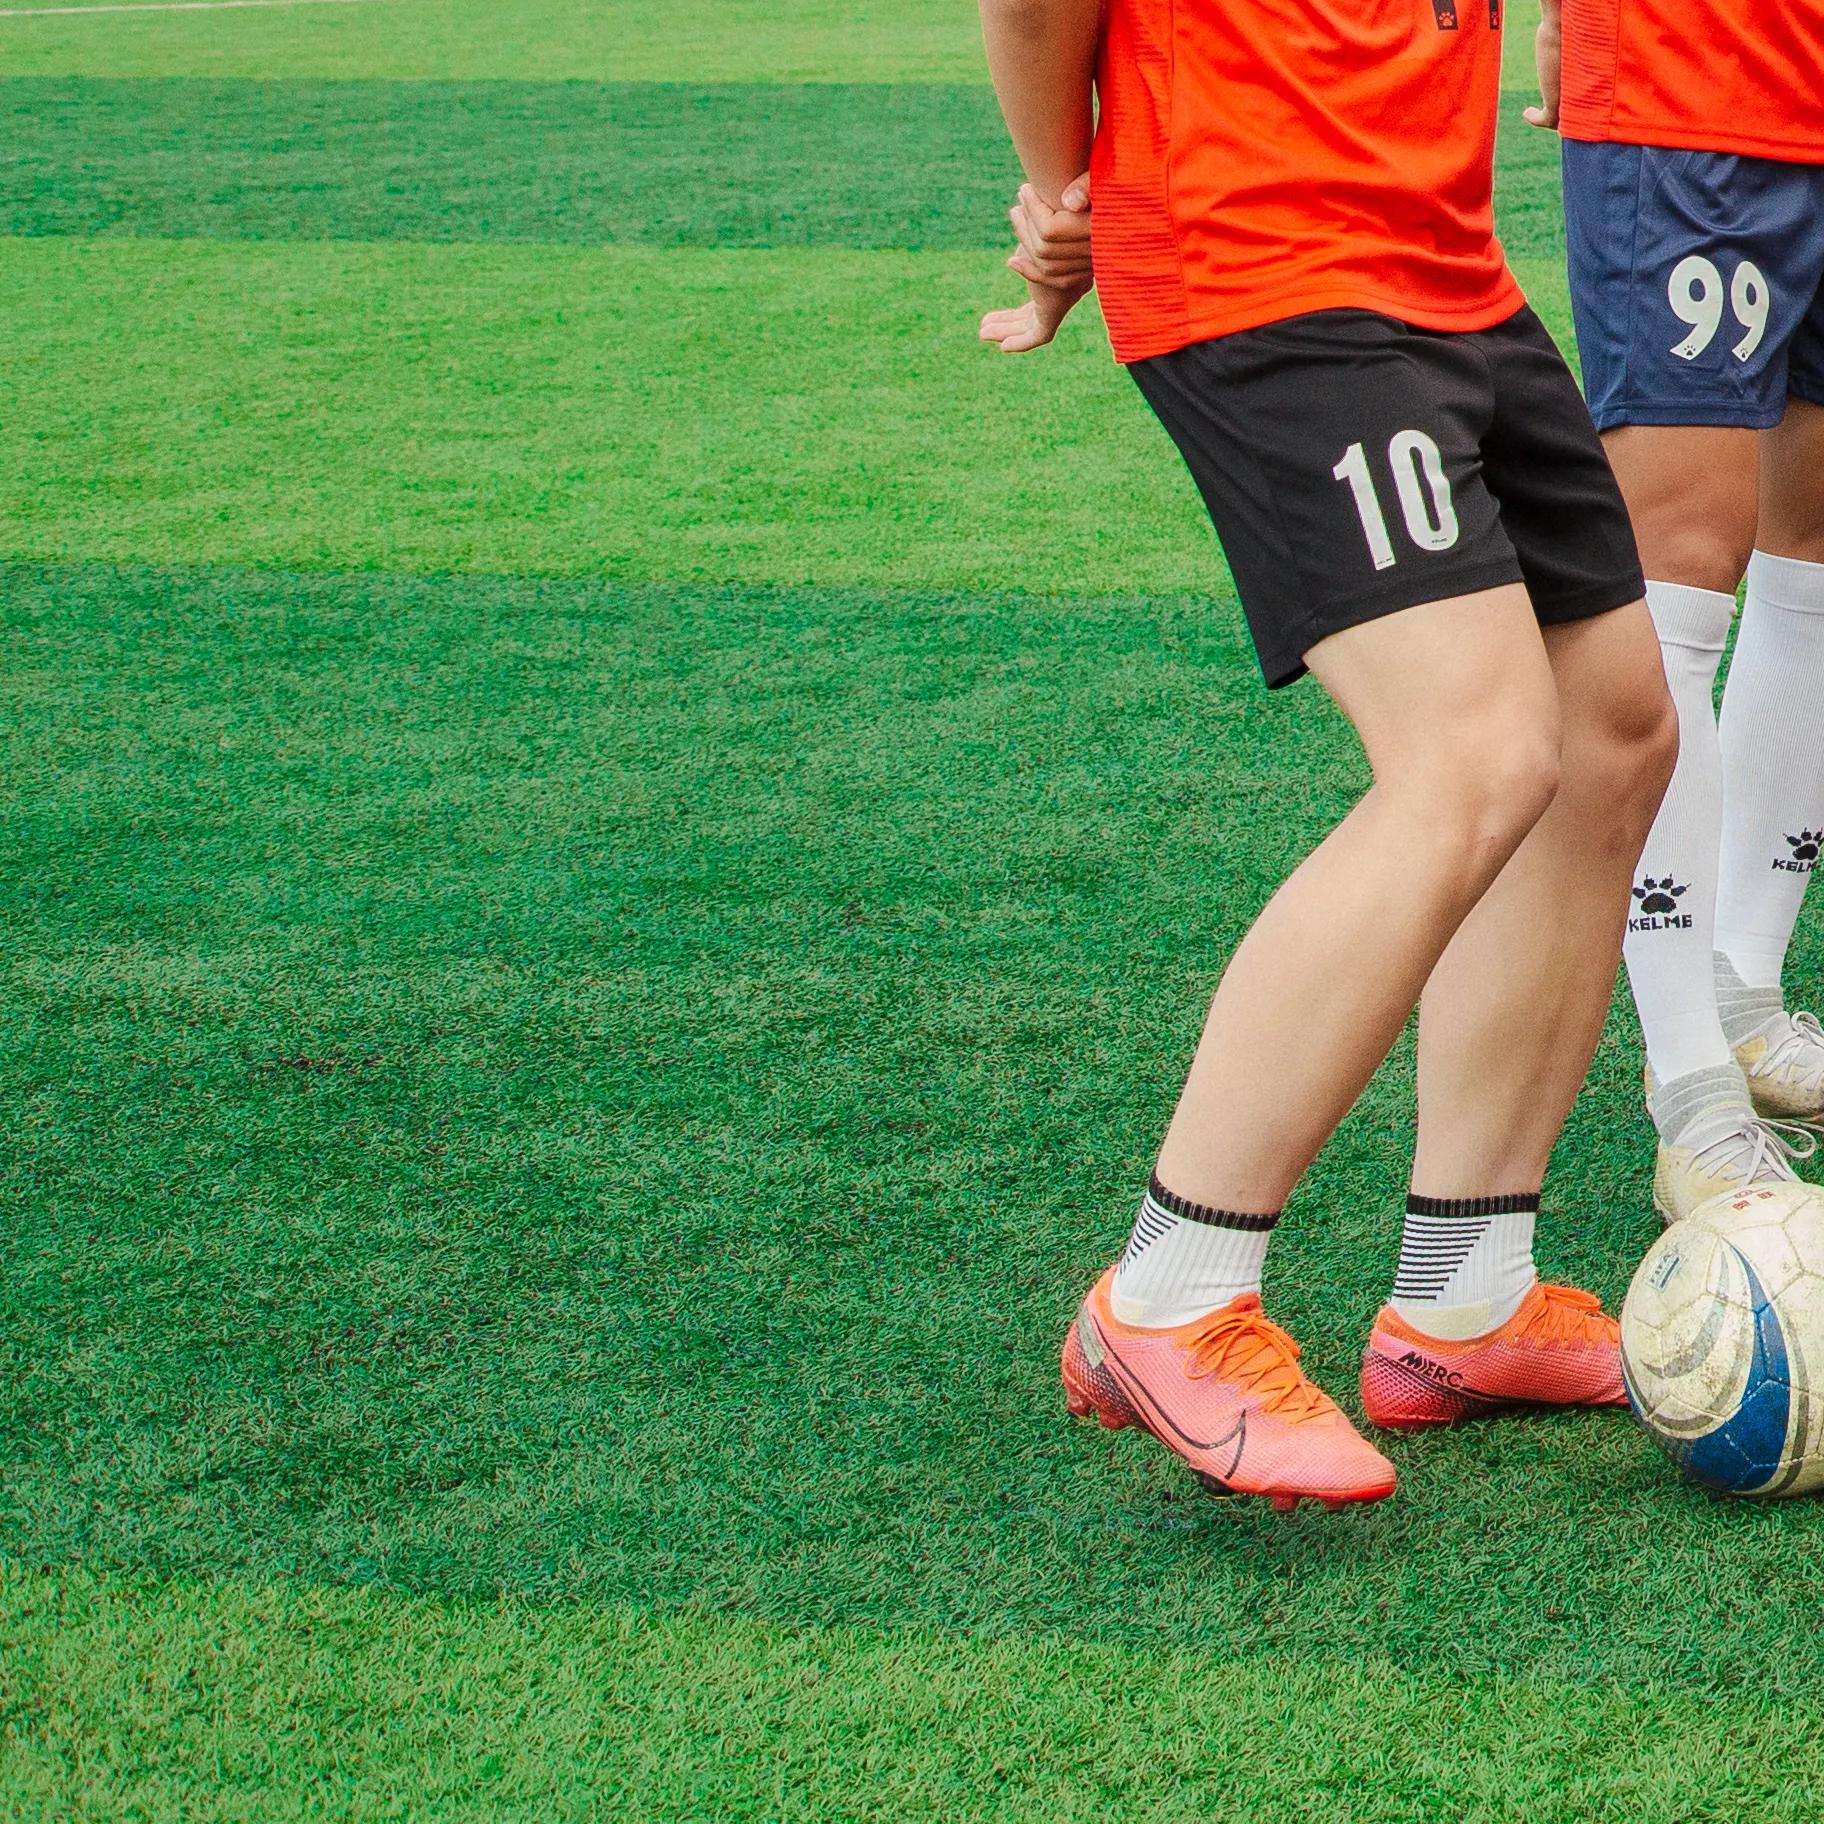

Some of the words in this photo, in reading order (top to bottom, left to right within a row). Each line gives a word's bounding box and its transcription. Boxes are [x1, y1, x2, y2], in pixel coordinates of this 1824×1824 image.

[1667, 255, 1770, 363] 99
[1332, 429, 1460, 572] 10
[1771, 858, 1819, 874] KELM
[1628, 914, 1693, 933] KELME
